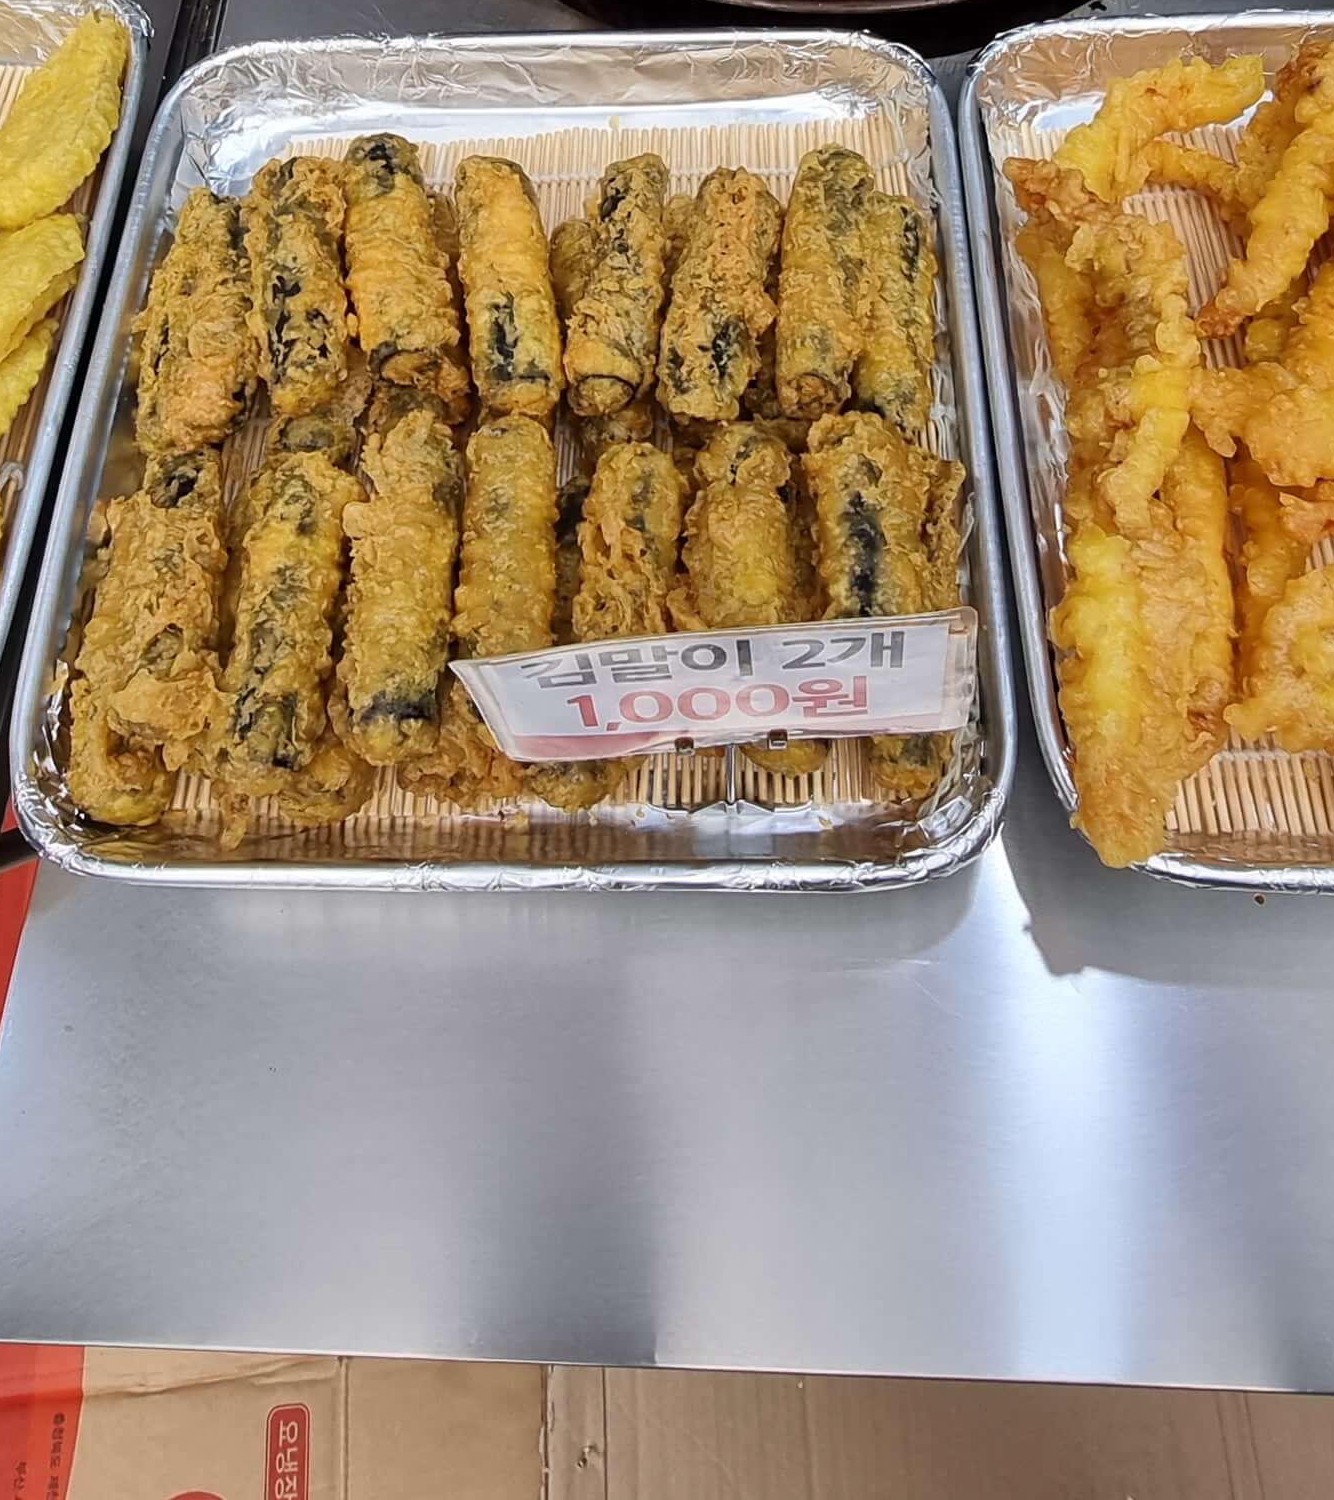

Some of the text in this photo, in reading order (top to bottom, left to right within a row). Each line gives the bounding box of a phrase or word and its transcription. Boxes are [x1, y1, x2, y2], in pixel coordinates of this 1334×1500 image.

[521, 631, 906, 690] 김말이 2개
[565, 675, 868, 732] 1,000원
